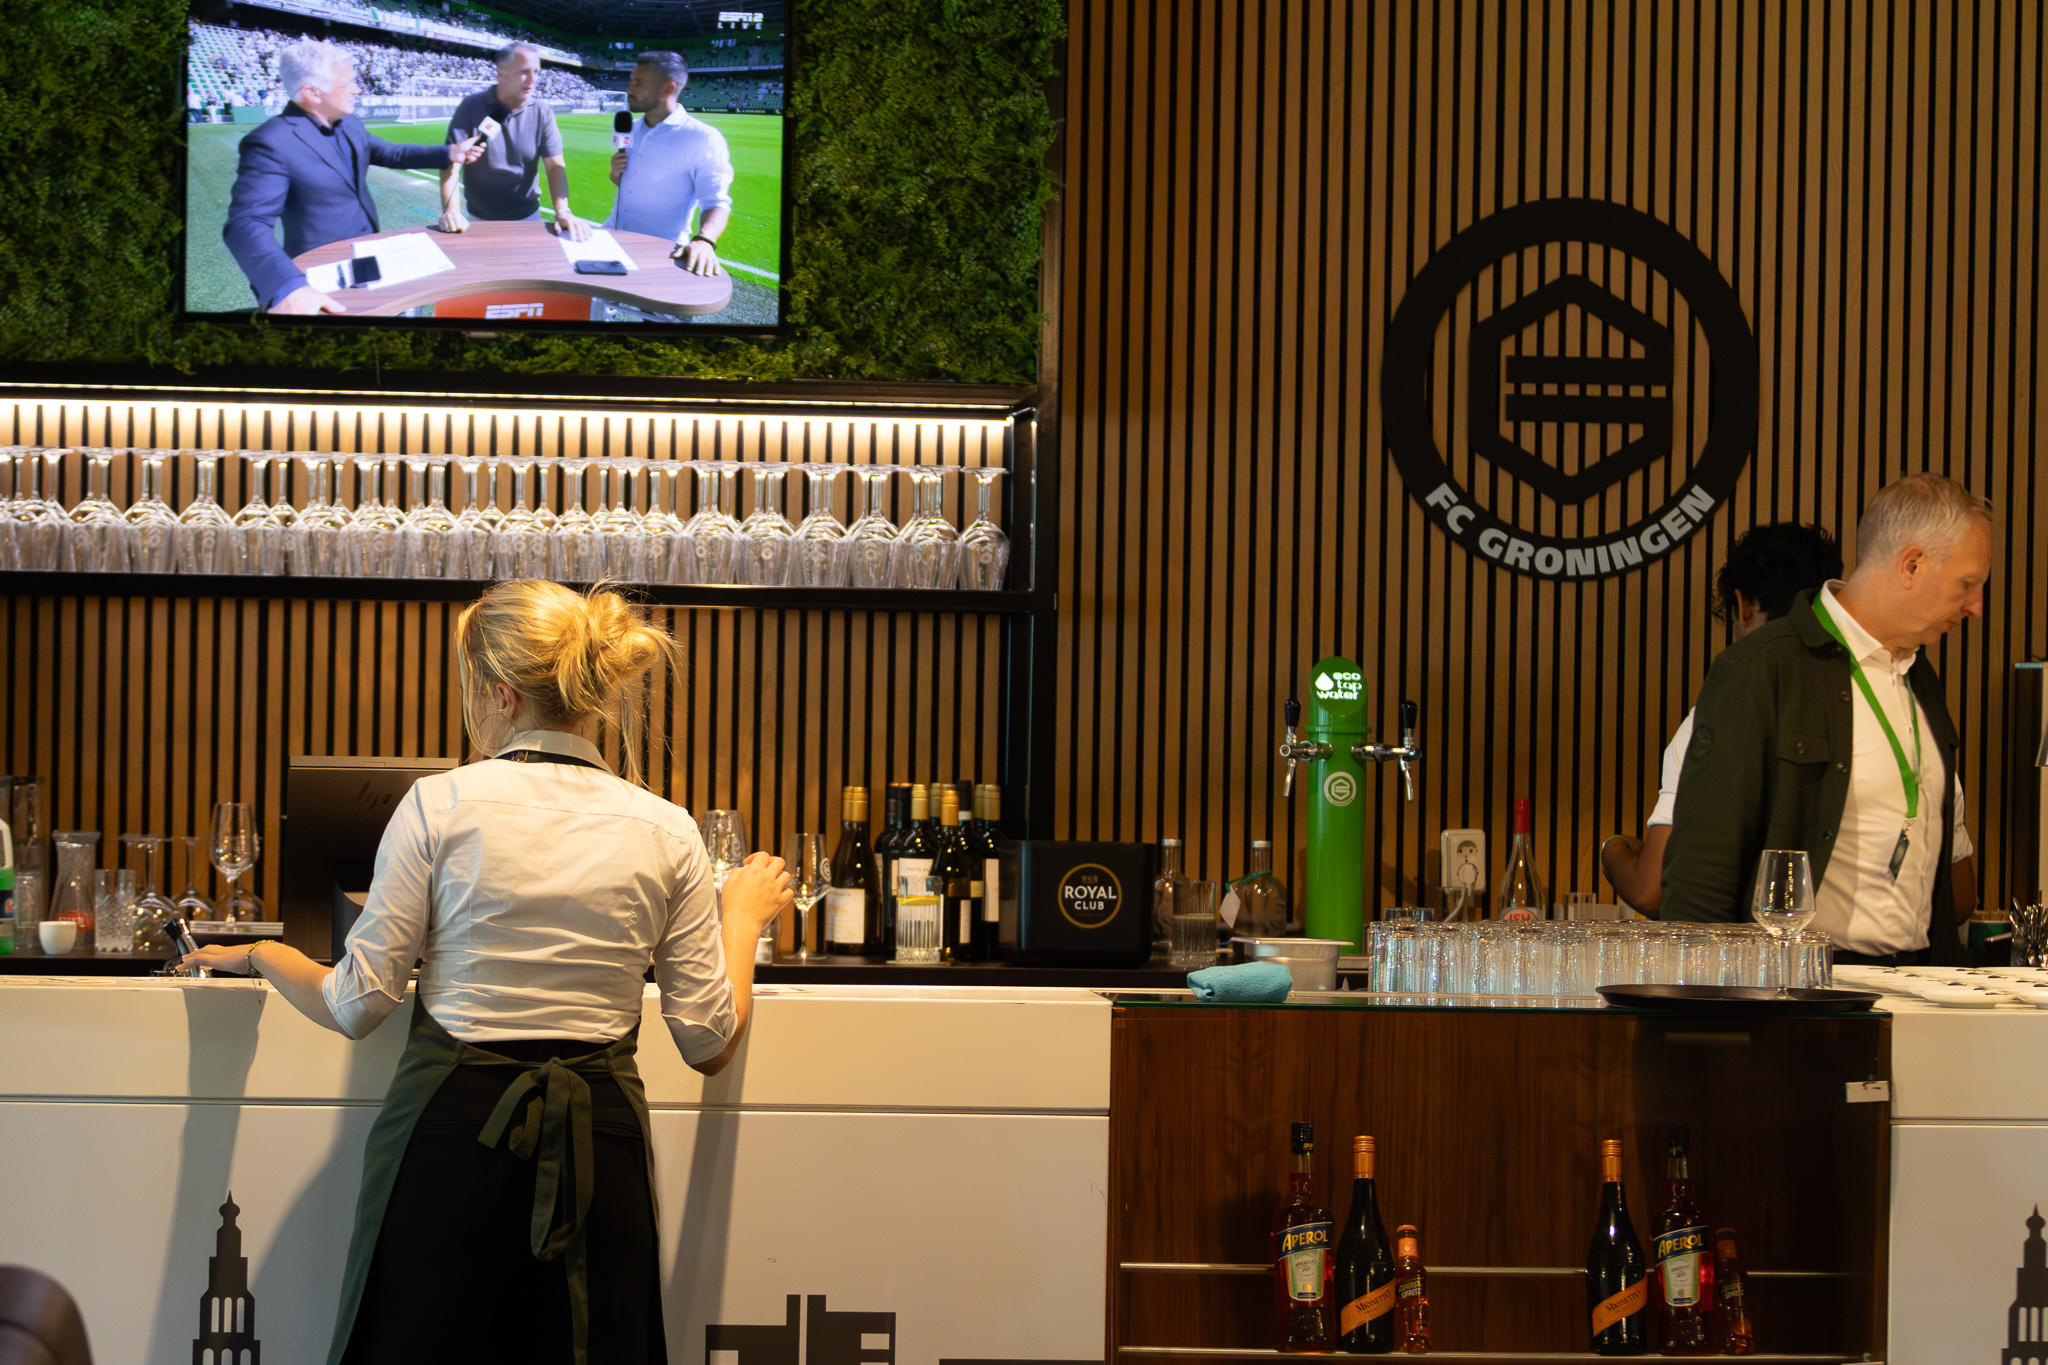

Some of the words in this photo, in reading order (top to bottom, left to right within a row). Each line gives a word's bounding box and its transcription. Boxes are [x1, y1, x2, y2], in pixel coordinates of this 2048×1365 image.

[485, 302, 544, 319] ESPN
[1425, 482, 1476, 535] FC
[1478, 484, 1715, 577] GRONINGEN
[1332, 672, 1362, 681] eco
[1337, 680, 1363, 692] tap
[1316, 689, 1359, 700] water
[1065, 886, 1117, 899] ROYAL
[1074, 900, 1105, 910] CLUB
[1282, 1229, 1328, 1253] APEROL
[1658, 1233, 1704, 1259] APEROL
